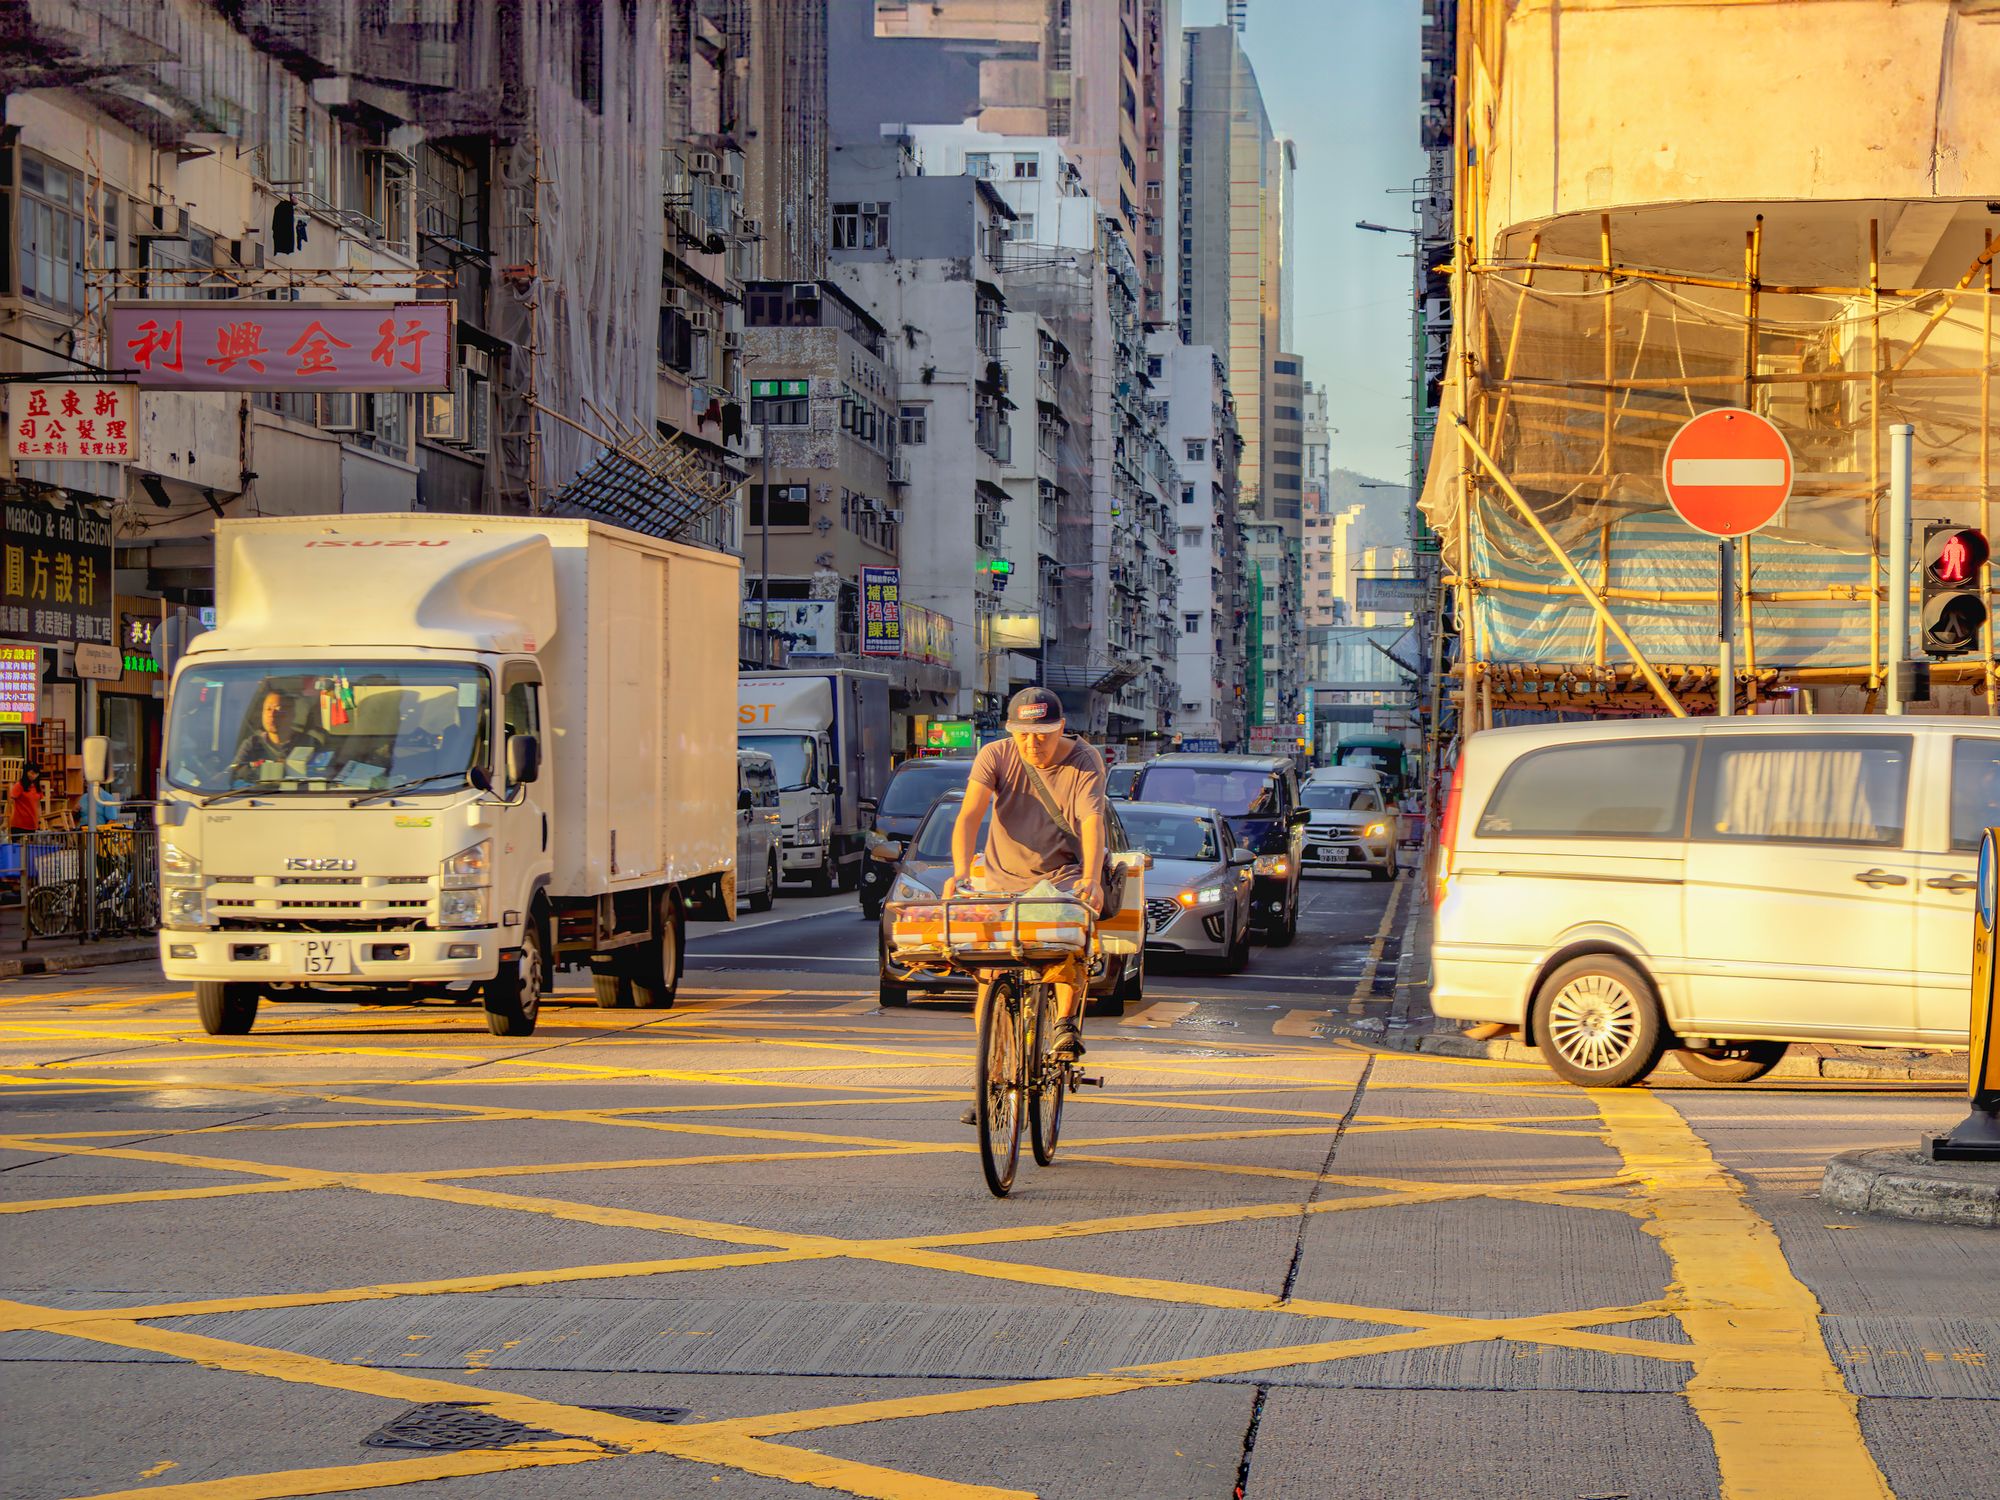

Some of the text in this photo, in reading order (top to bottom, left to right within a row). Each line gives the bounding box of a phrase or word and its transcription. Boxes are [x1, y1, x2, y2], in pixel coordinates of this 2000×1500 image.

[127, 319, 430, 374] 利興金行
[46, 513, 55, 537] &
[60, 516, 74, 540] FAI
[79, 520, 111, 547] DESIGN
[304, 540, 451, 548] ISUZU
[6, 544, 97, 606] 圓方設計
[867, 584, 898, 601] 補習
[867, 601, 899, 621] 招生
[867, 621, 900, 639] 課程
[0, 648, 36, 661] 方設計
[284, 858, 356, 872] ISUZU
[307, 941, 332, 955] PV
[305, 957, 334, 972] 157
